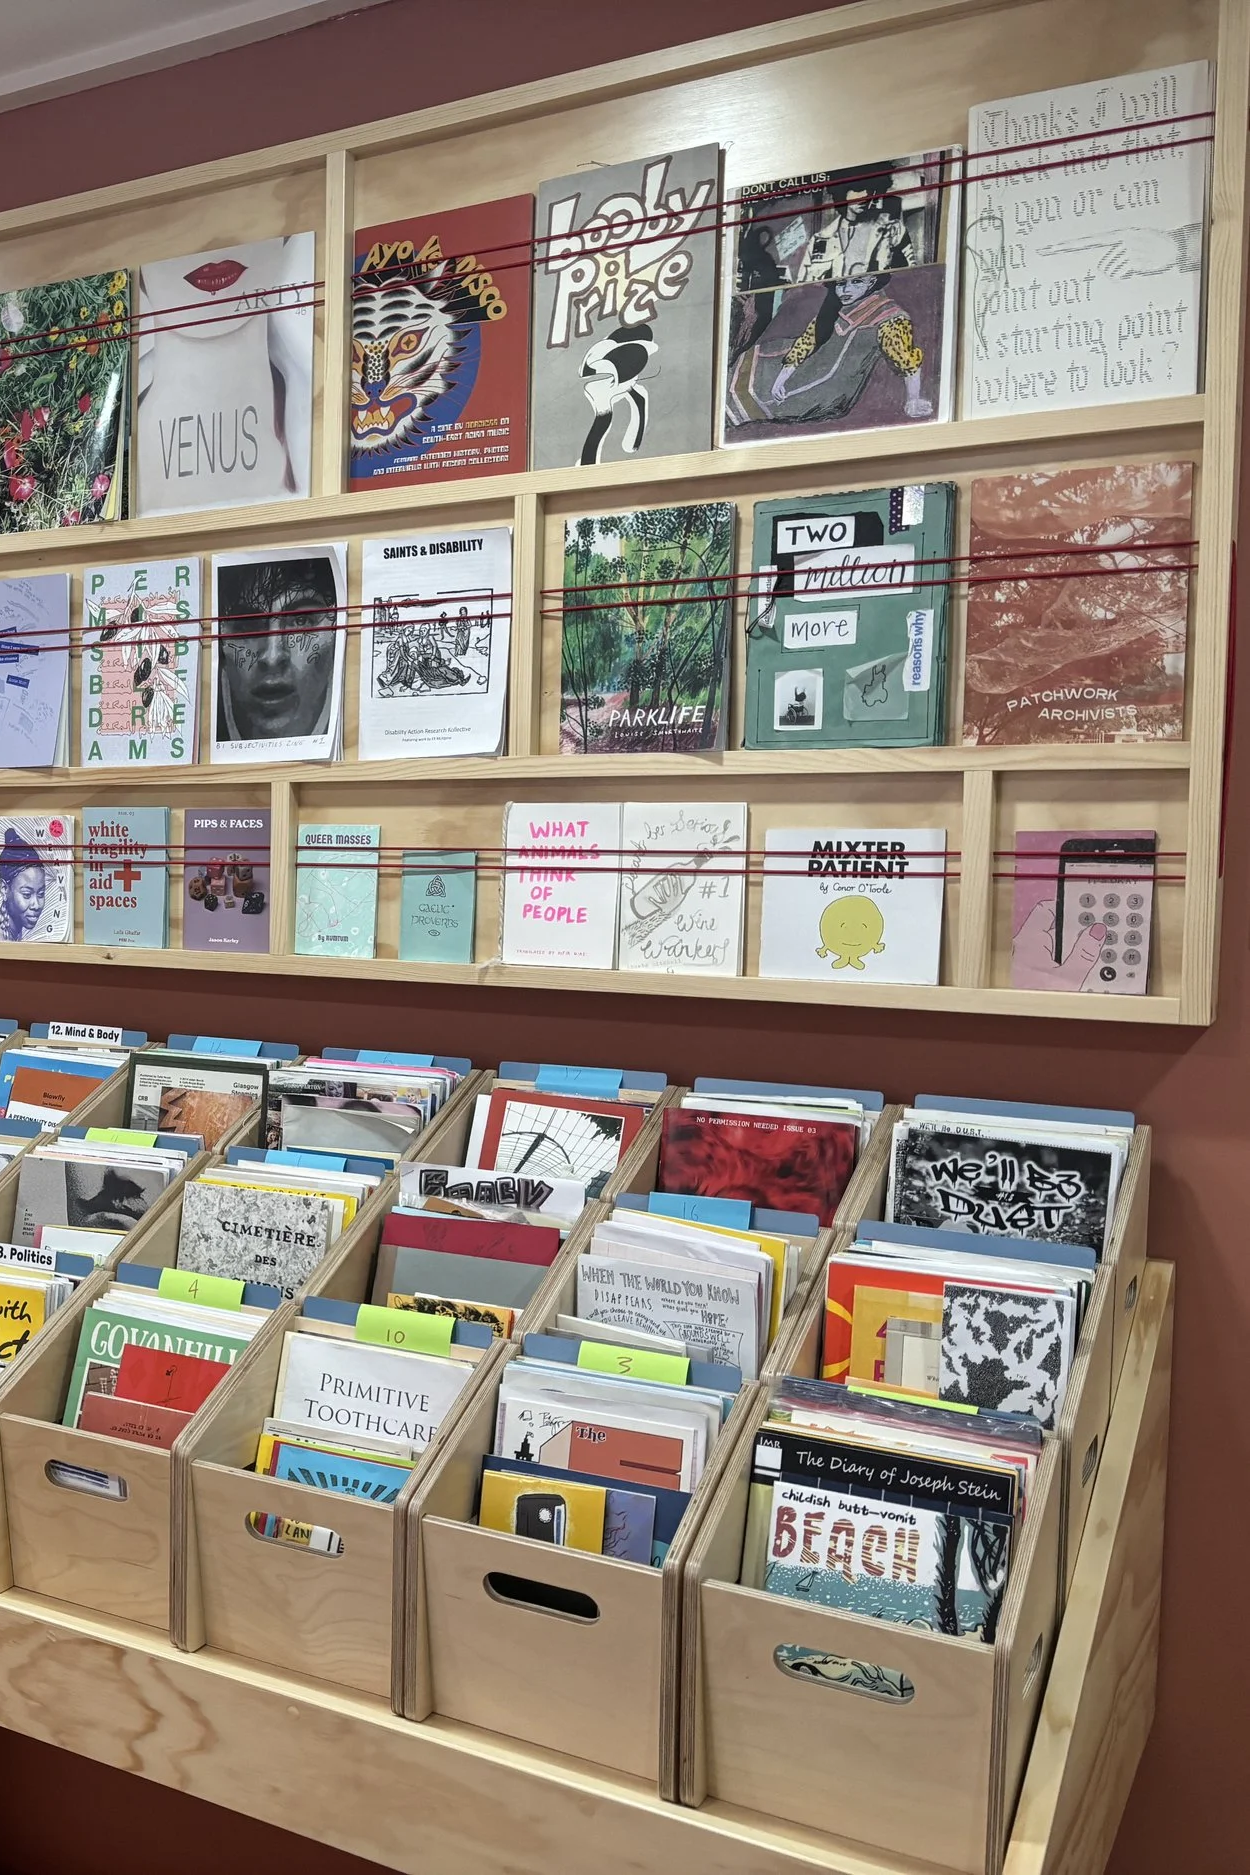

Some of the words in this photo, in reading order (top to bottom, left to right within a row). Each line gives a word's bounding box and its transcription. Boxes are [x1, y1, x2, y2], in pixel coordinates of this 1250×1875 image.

[778, 176, 808, 190] CALL
[1118, 298, 1188, 350] point
[1066, 360, 1090, 392] to
[1102, 347, 1153, 388] look
[158, 405, 259, 480] VENUS
[785, 522, 848, 547] TWO
[383, 544, 417, 560] SAINTS
[420, 544, 427, 556] &
[428, 539, 483, 556] DISABILITY
[804, 555, 906, 592] million
[790, 616, 850, 642] more
[912, 608, 928, 637] why
[910, 637, 924, 687] reasons
[1006, 687, 1120, 712] PATCHWORK
[608, 704, 708, 728] PARKLIFE
[1038, 704, 1138, 721] ARCHIVISTS
[88, 820, 129, 838] white
[194, 820, 218, 828] PIPS
[220, 820, 228, 828] &
[230, 820, 264, 829] FACES
[529, 820, 590, 839] WHAT
[88, 838, 148, 860] fragility
[305, 834, 332, 846] QUEER
[335, 834, 372, 846] MASSES
[810, 840, 906, 860] MIXTER
[518, 865, 577, 883] THINK
[808, 859, 910, 880] PATIENT
[90, 873, 114, 890] aid
[832, 884, 856, 892] Conor
[90, 894, 138, 910] spaces
[530, 886, 554, 900] OF
[522, 904, 588, 924] PEOPLE
[50, 1024, 63, 1036] 12.
[65, 1026, 86, 1039] Mind
[88, 1029, 95, 1040] &
[96, 1030, 120, 1044] Body
[233, 1081, 260, 1092] Glasgow
[42, 1092, 66, 1102] Blowfly
[708, 1117, 750, 1128] PERMISSION
[753, 1122, 779, 1132] NEEDED
[782, 1124, 804, 1134] ISSUE
[220, 1219, 316, 1246] CIMETIÈRE
[10, 1248, 52, 1266] Politics
[254, 1254, 278, 1267] DES
[188, 1278, 199, 1299] 4
[580, 1264, 616, 1287] WHEN
[618, 1272, 641, 1289] THE
[644, 1275, 682, 1296] WORLD
[681, 1280, 704, 1298] YOU
[706, 1282, 740, 1306] KNOW
[385, 1328, 406, 1345] 10
[617, 1356, 634, 1374] 3
[319, 1372, 430, 1413] PRIMITIVE
[575, 1424, 608, 1442] The
[796, 1450, 825, 1468] The
[830, 1456, 875, 1482] Diary
[879, 1468, 897, 1483] of
[900, 1472, 956, 1497] Joseph
[958, 1480, 1002, 1502] Stein
[782, 1488, 831, 1509] childish
[772, 1504, 921, 1587] BEACH
